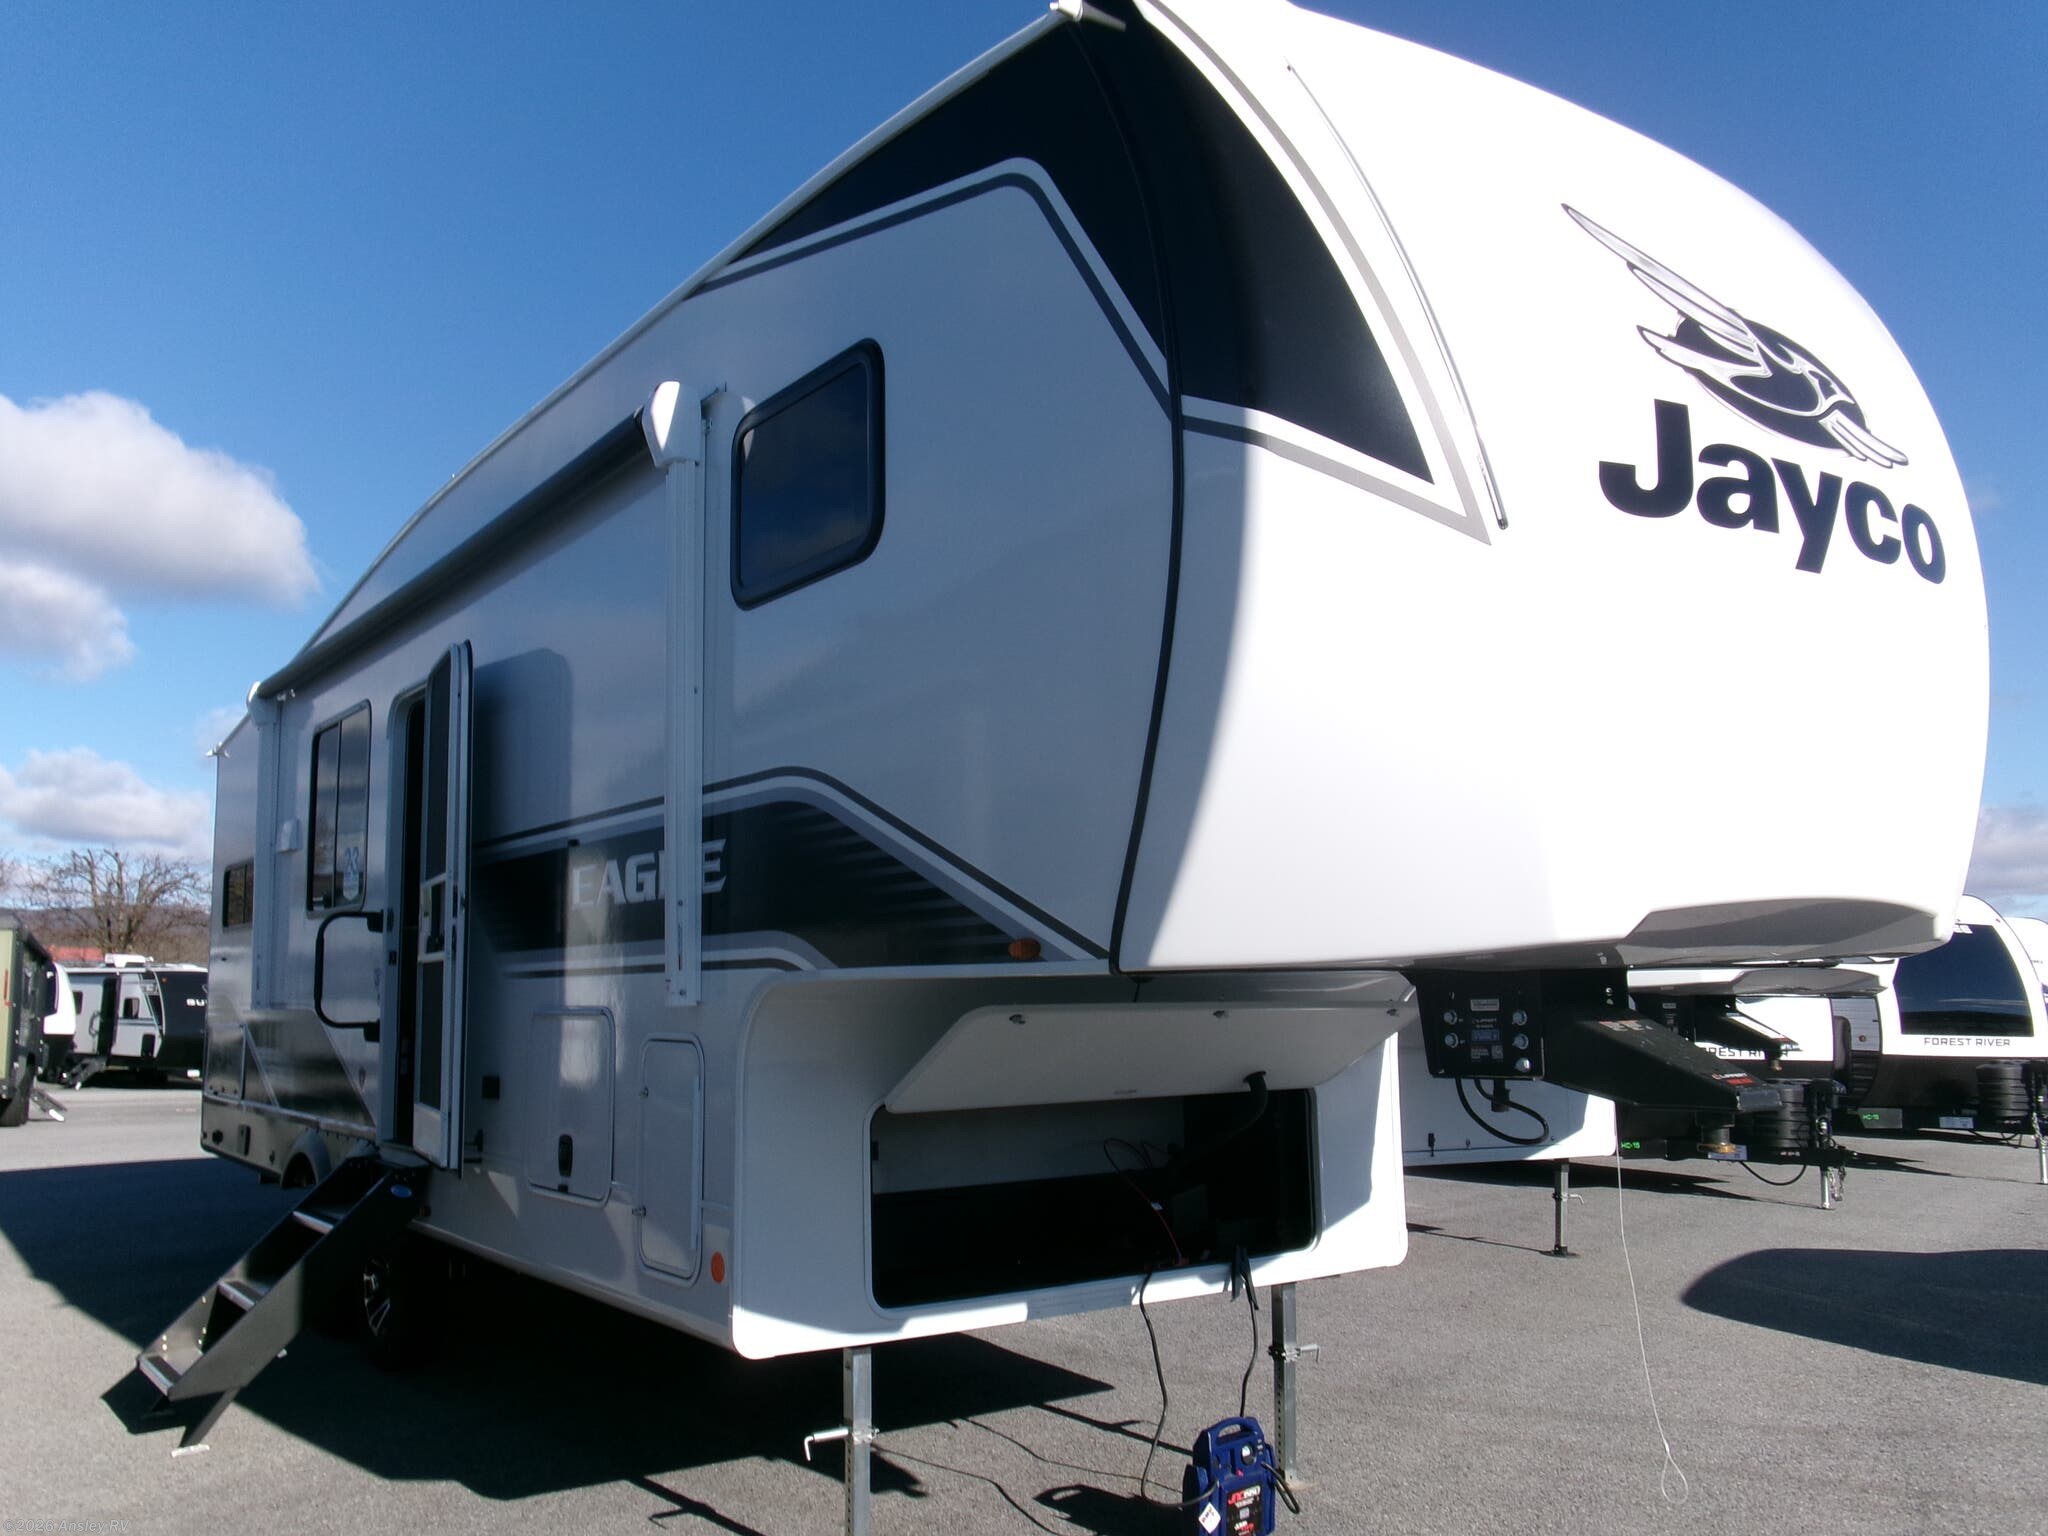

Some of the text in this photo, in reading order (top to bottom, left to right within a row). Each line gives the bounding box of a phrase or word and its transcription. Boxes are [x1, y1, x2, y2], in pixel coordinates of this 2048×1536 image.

[1599, 398, 1946, 585] Jayco
[1924, 1037, 2011, 1047] FOREST RIVER
